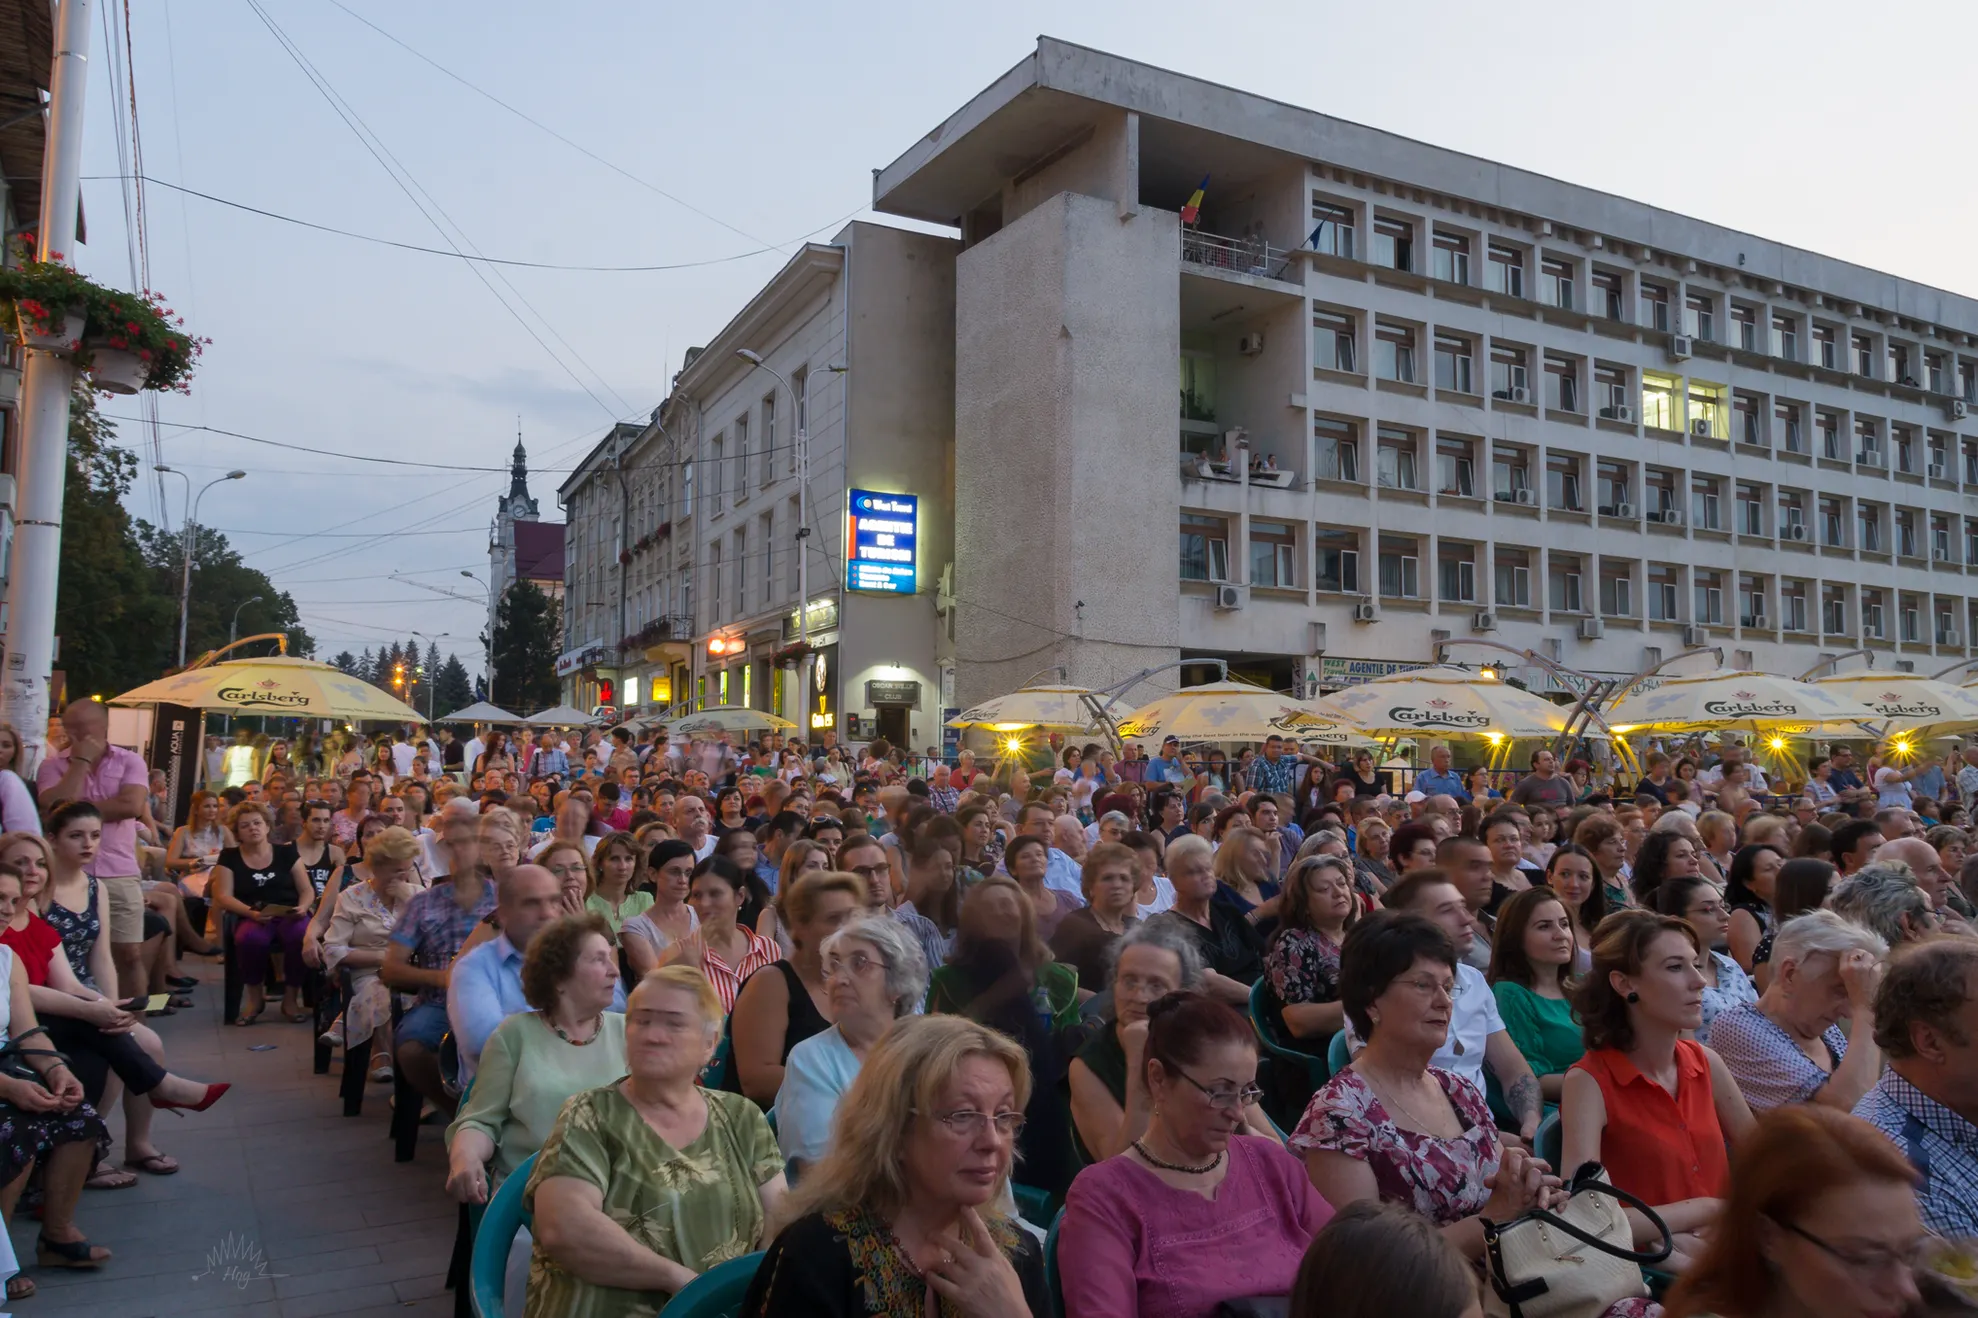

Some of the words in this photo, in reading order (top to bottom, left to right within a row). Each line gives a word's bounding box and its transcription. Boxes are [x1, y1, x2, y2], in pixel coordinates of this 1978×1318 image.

[1323, 659, 1346, 668] WEST
[1349, 662, 1385, 675] AGENTIE
[217, 687, 311, 707] Carlsberg
[960, 708, 1001, 722] Carlsberg
[1388, 707, 1490, 728] Carlsberg
[1704, 700, 1797, 718] Carlsberg
[1862, 702, 1941, 718] rlsberg
[170, 731, 180, 754] AQUA
